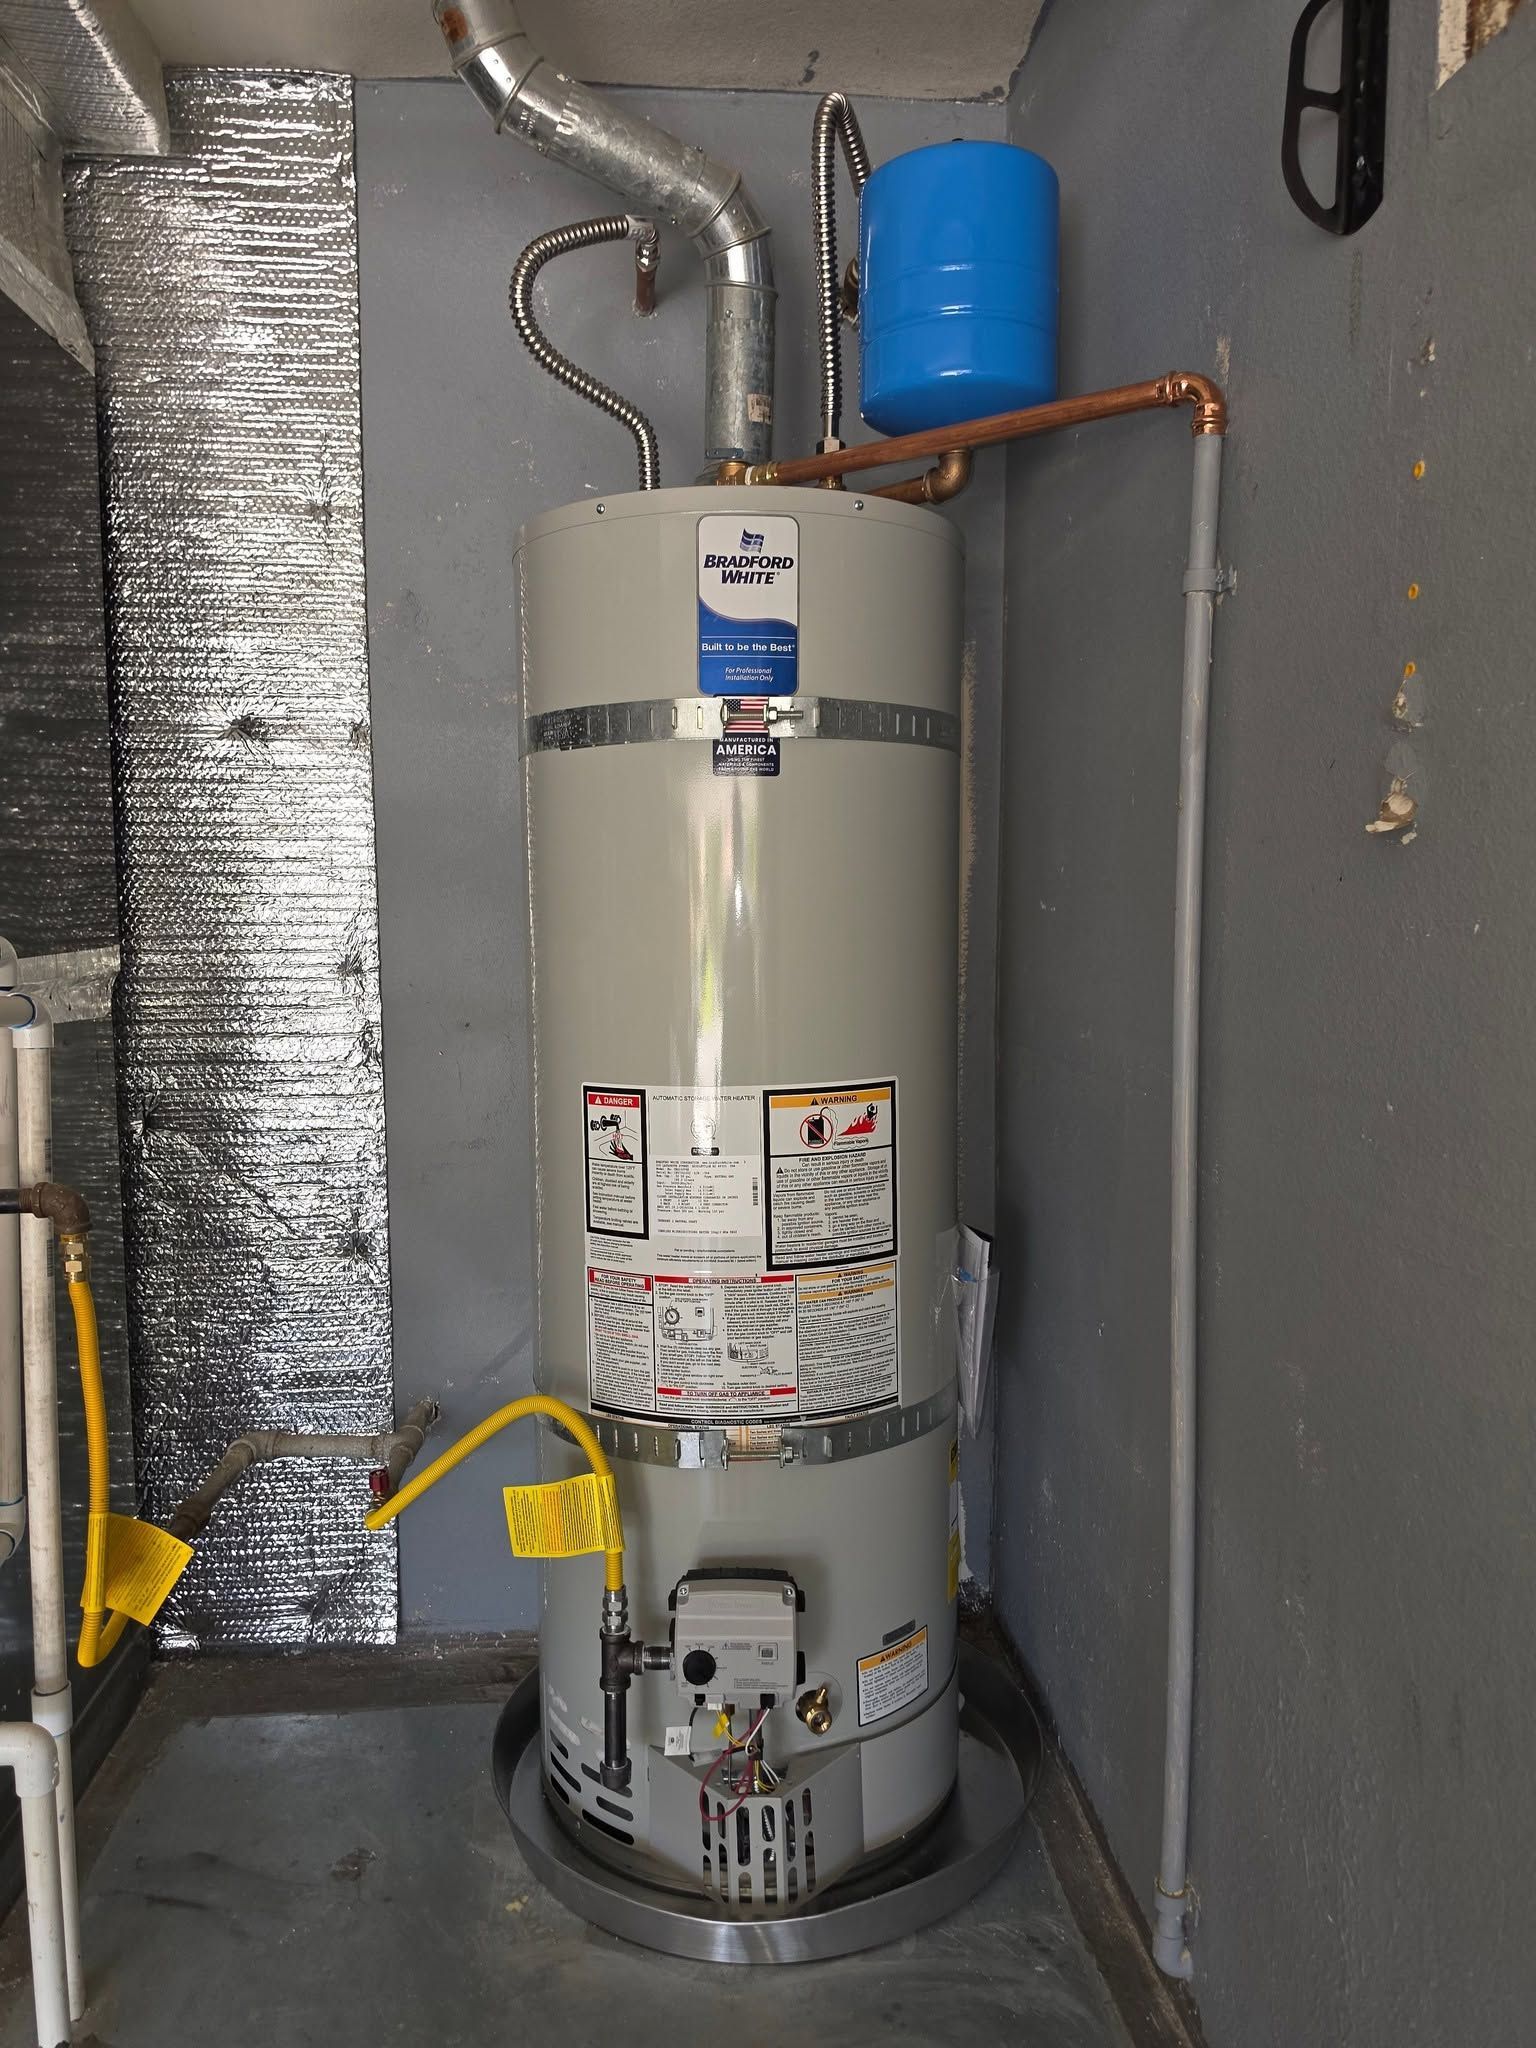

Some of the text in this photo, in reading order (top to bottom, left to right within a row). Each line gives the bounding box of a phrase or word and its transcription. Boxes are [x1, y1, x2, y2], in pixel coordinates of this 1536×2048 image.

[703, 554, 794, 569] BRADFORD
[702, 643, 722, 651] Built
[725, 643, 734, 651] to
[737, 643, 749, 651] be
[752, 643, 767, 651] the
[716, 744, 776, 755] AMERICA
[603, 1097, 633, 1106] DANGER
[821, 1095, 857, 1105] WARNING
[885, 1641, 912, 1660] WARNING
